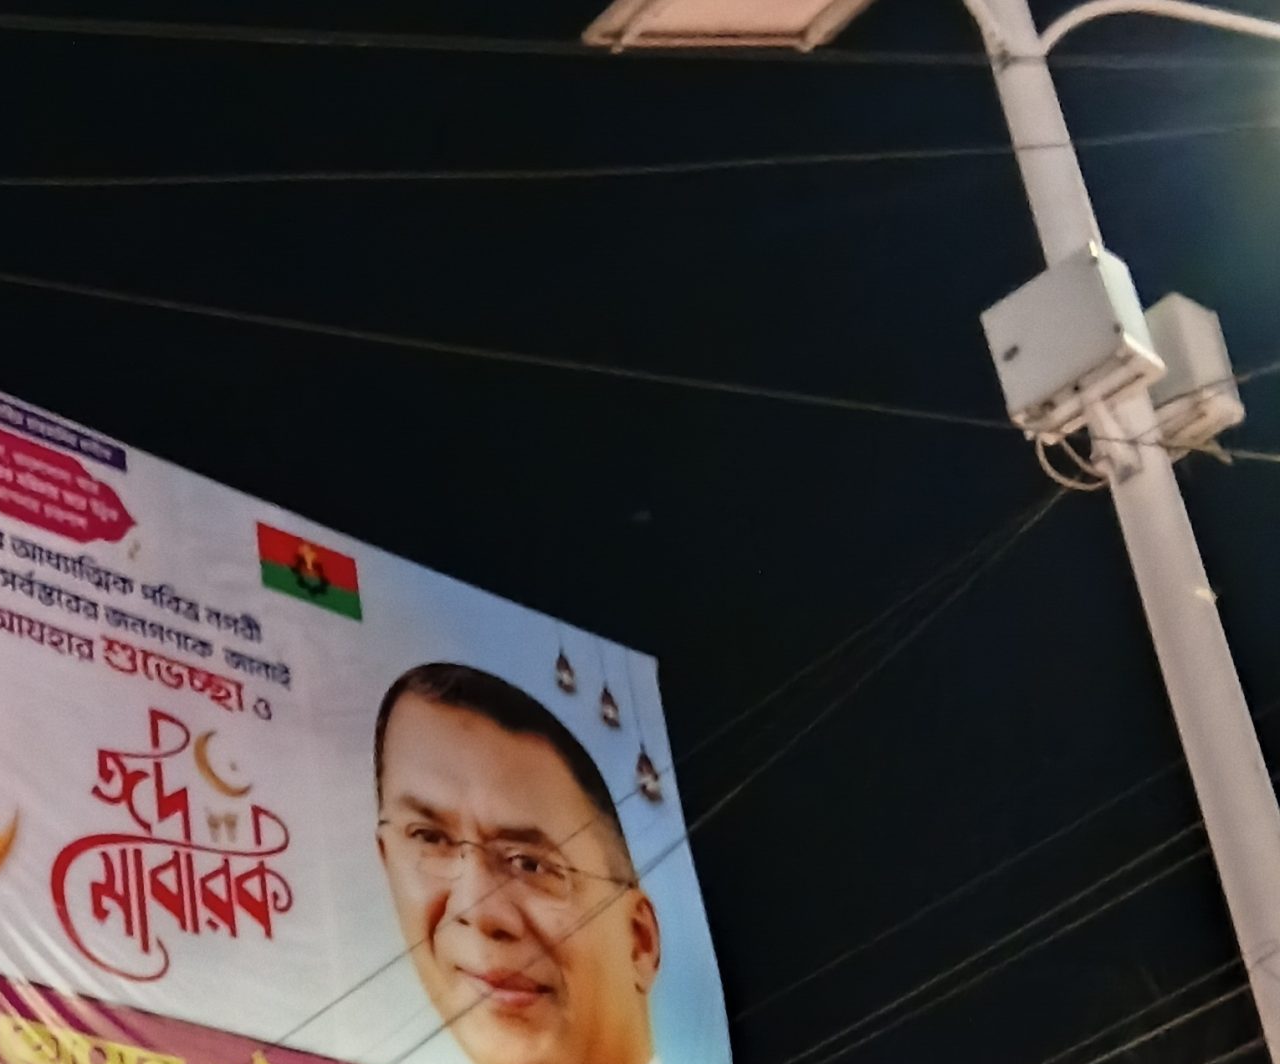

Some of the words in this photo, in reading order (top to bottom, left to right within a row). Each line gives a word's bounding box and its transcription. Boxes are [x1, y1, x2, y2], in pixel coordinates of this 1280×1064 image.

[100, 634, 245, 713] শুভেচ্ছা
[252, 697, 273, 721] ও
[91, 707, 193, 842] ঈদ
[50, 803, 294, 983] মোবারক
